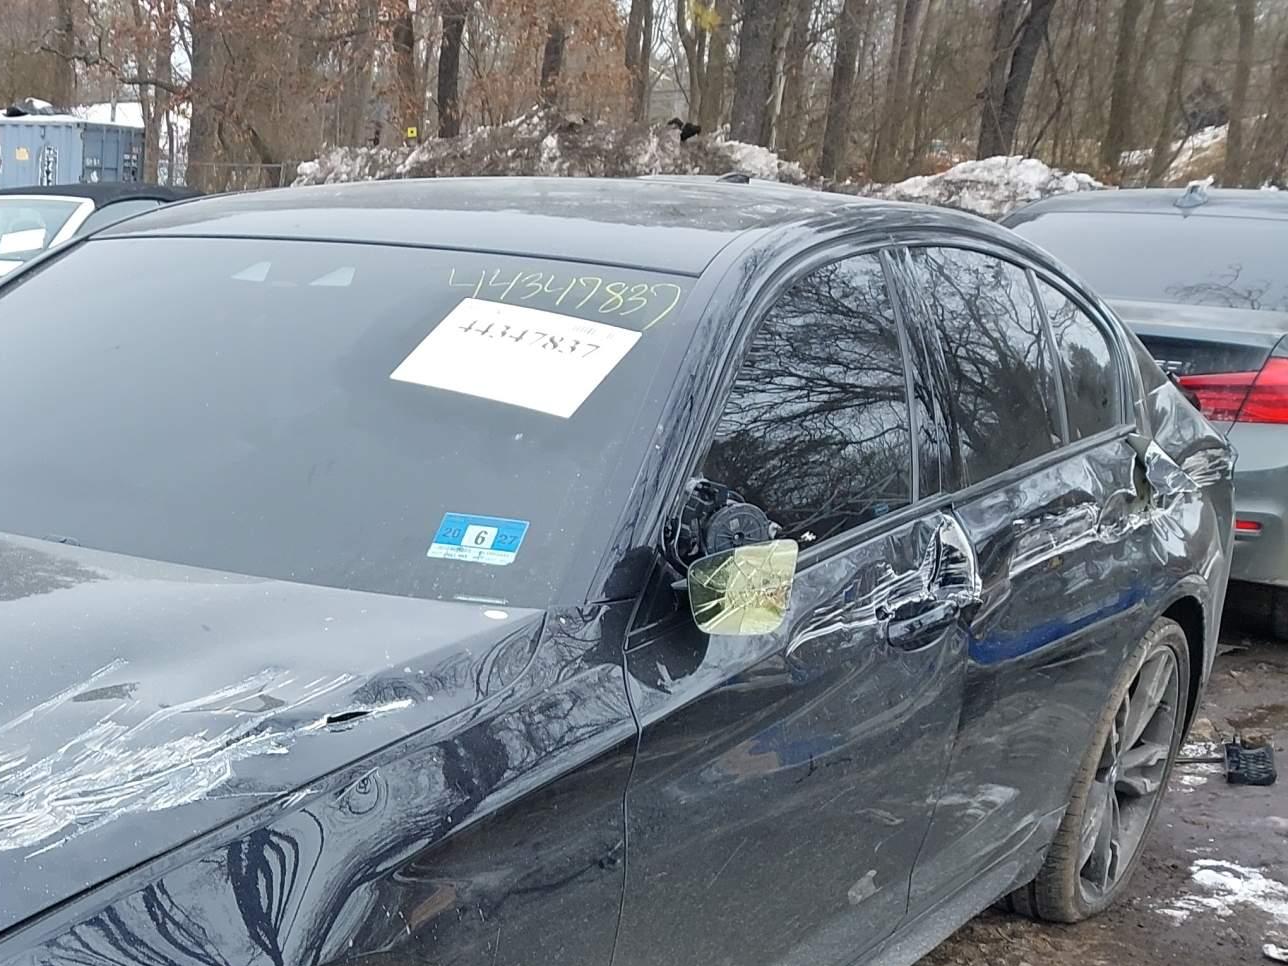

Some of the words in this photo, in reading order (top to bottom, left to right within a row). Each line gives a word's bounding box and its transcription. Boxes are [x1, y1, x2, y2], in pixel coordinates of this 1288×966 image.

[448, 267, 682, 331] 44347837
[458, 319, 601, 359] 44347837
[443, 527, 462, 538] 20
[473, 529, 489, 546] 6
